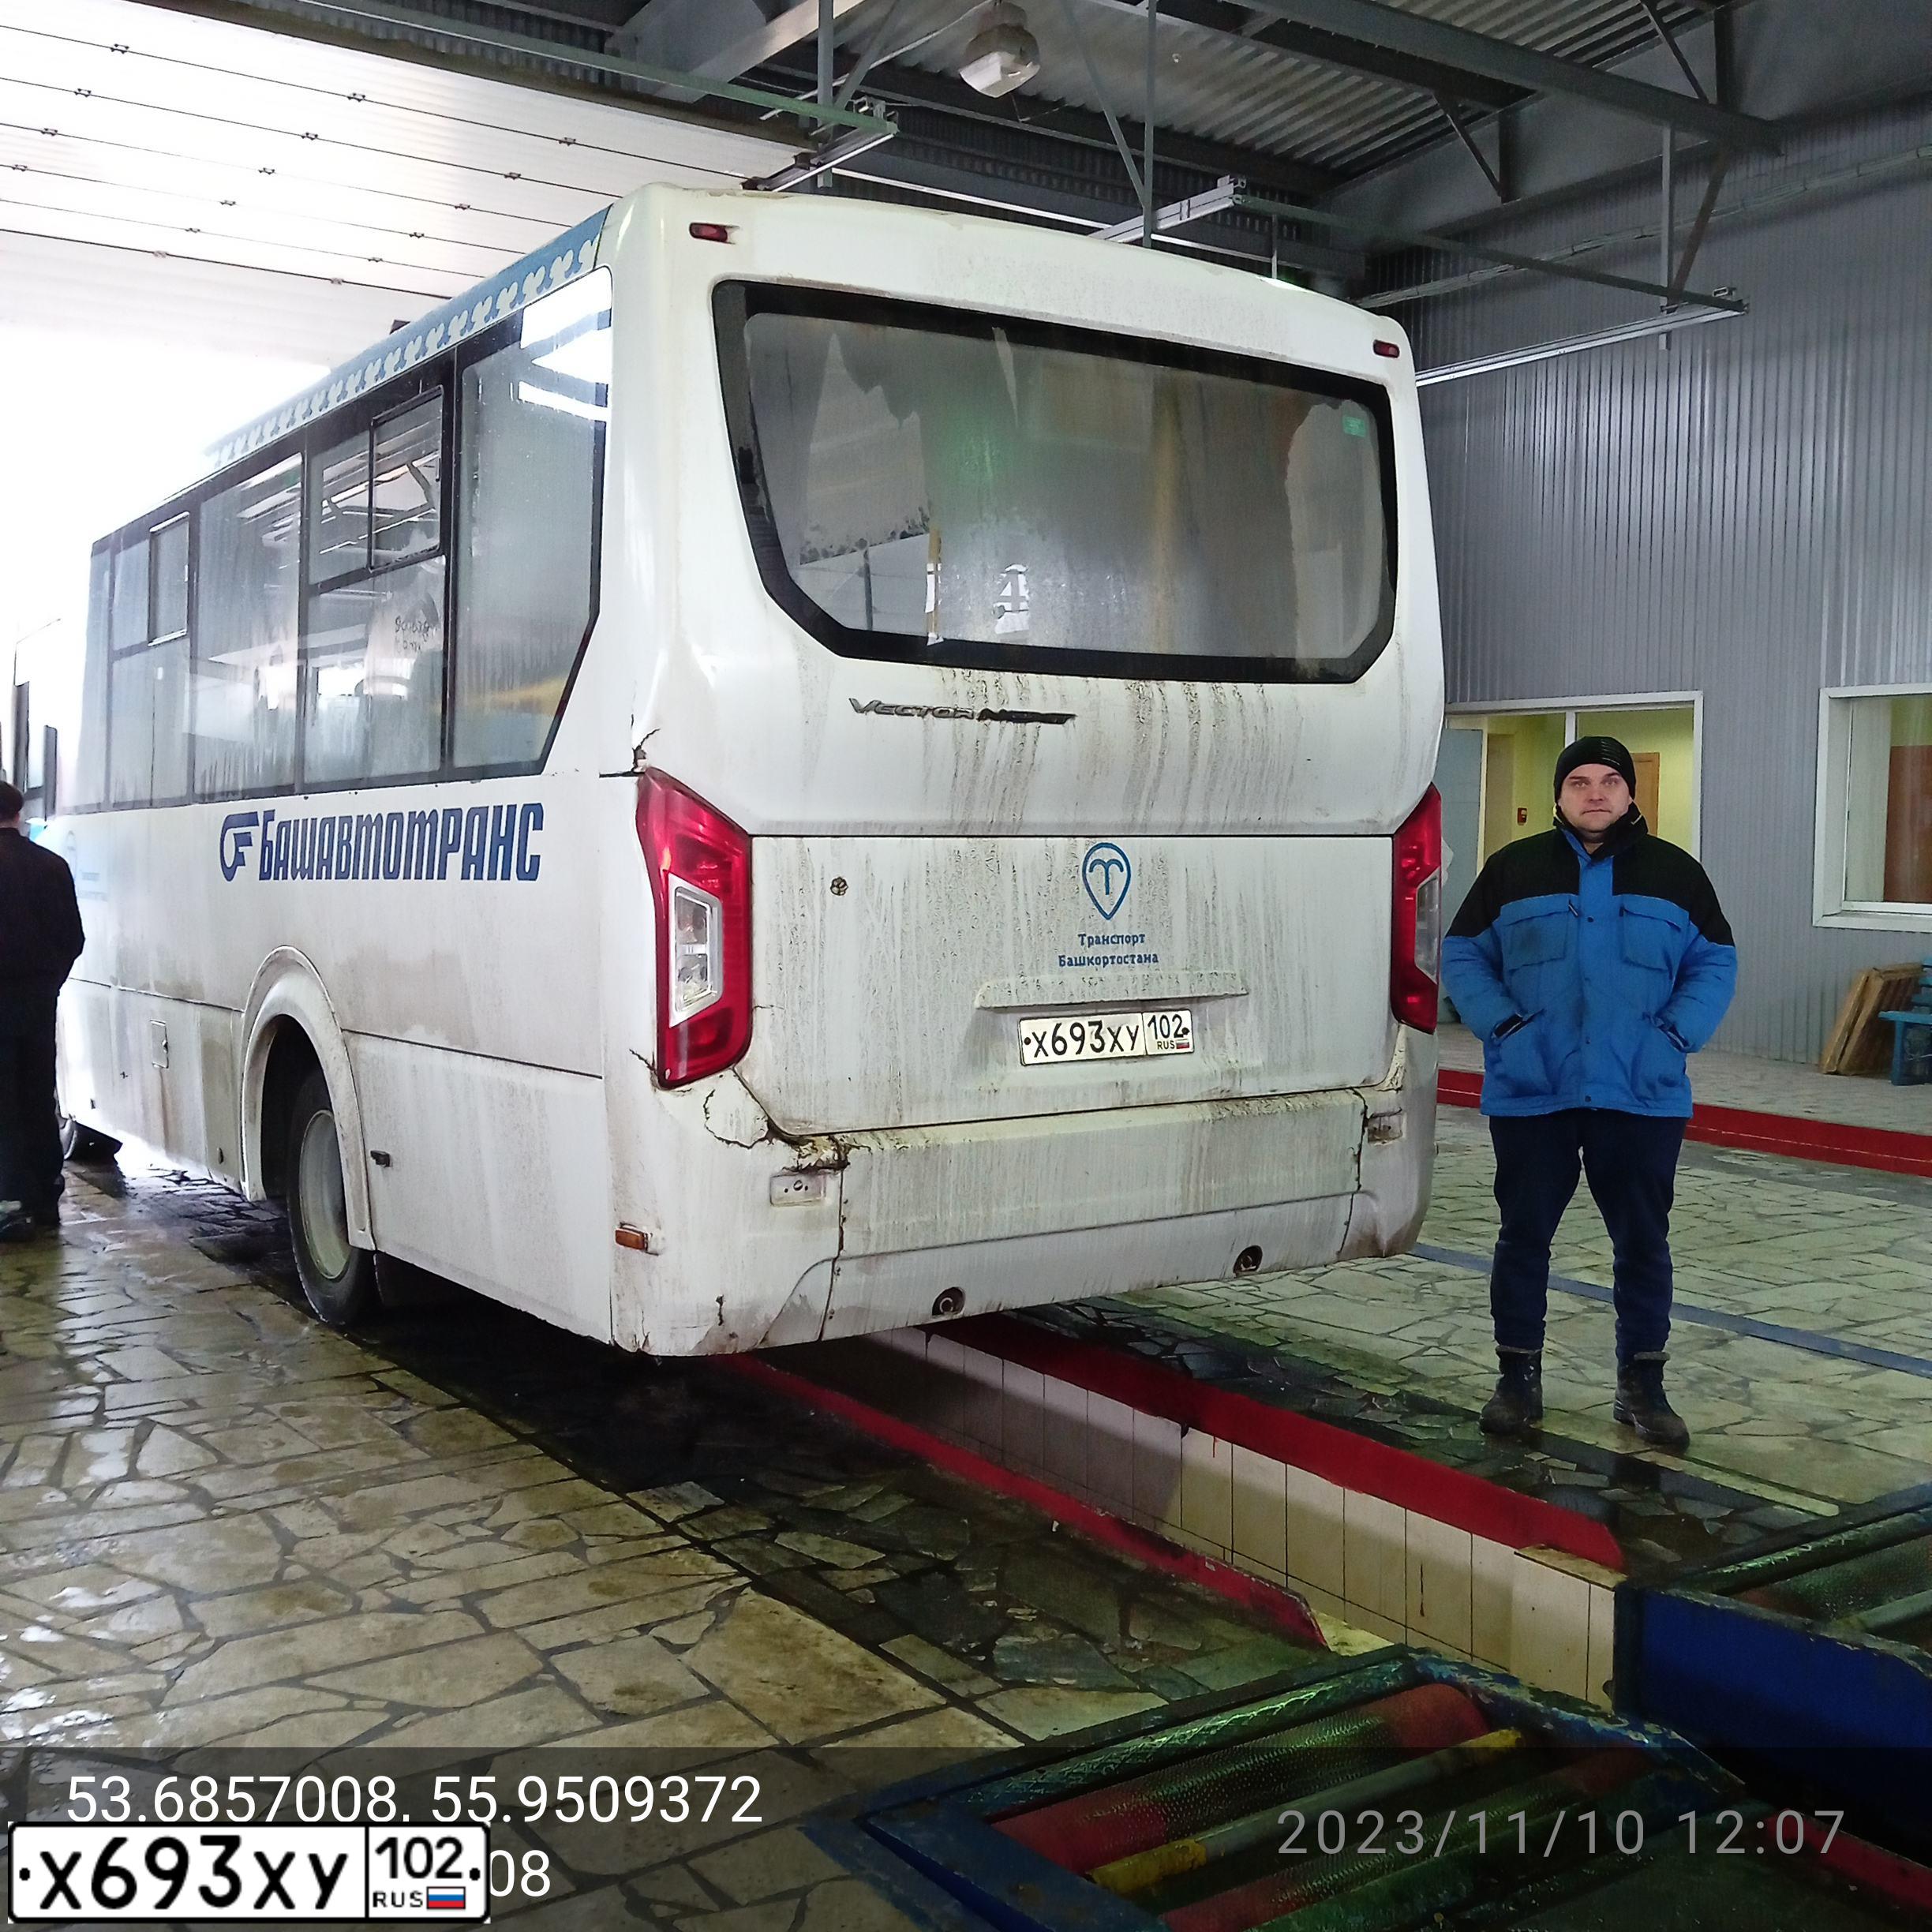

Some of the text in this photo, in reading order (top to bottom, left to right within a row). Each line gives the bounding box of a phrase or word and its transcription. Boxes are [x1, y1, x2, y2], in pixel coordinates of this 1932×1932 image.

[1077, 933, 1146, 949] Транспорт
[1058, 953, 1159, 968] Башкортостана
[1147, 1013, 1184, 1040] 102
[1156, 1039, 1175, 1050] RUS
